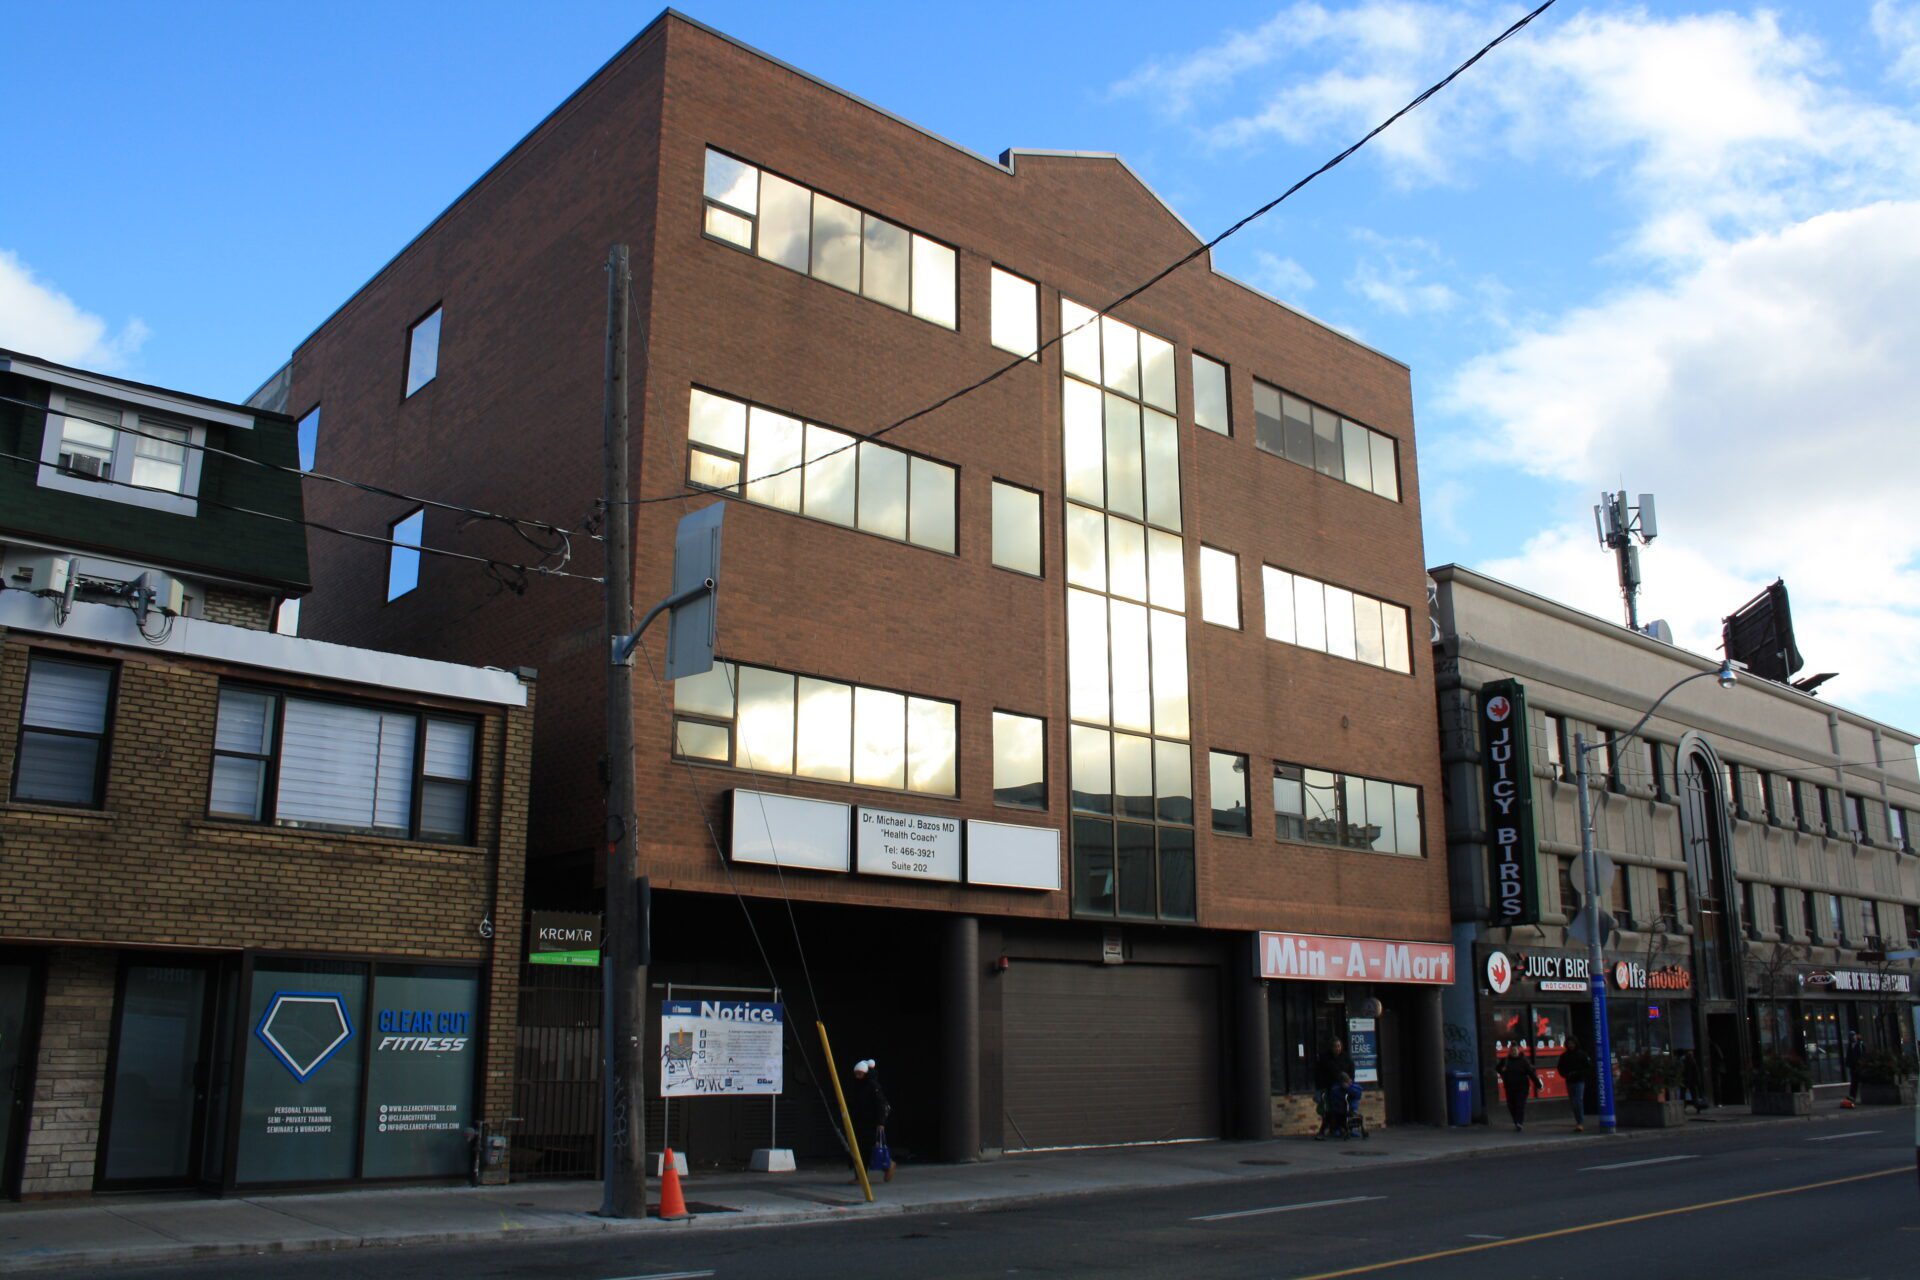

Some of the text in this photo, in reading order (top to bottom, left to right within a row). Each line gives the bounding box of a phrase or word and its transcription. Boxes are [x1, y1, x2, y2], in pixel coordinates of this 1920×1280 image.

[863, 813, 955, 833] Dr. Michael J. Bazos MD
[1491, 727, 1522, 916] JUICY BIRDS
[881, 829, 937, 842] "Health Coach"
[884, 845, 935, 858] Tel: 466-3921
[892, 861, 928, 872] Suite 202
[539, 927, 592, 942] KRCMAR
[1525, 956, 1562, 977] JUICY
[378, 1009, 470, 1034] CLEAR CUT
[377, 1036, 469, 1052] FITNESS
[1352, 1034, 1365, 1044] FOR
[1352, 1044, 1371, 1054] LEASE
[274, 1106, 327, 1114] PERSONAL TRAINING
[267, 1116, 281, 1124] SEMI
[285, 1116, 307, 1124] PRIVATE
[308, 1115, 332, 1123] TRAINING
[266, 1125, 293, 1133] SEMINARS
[299, 1125, 332, 1133] WORKSHOPS
